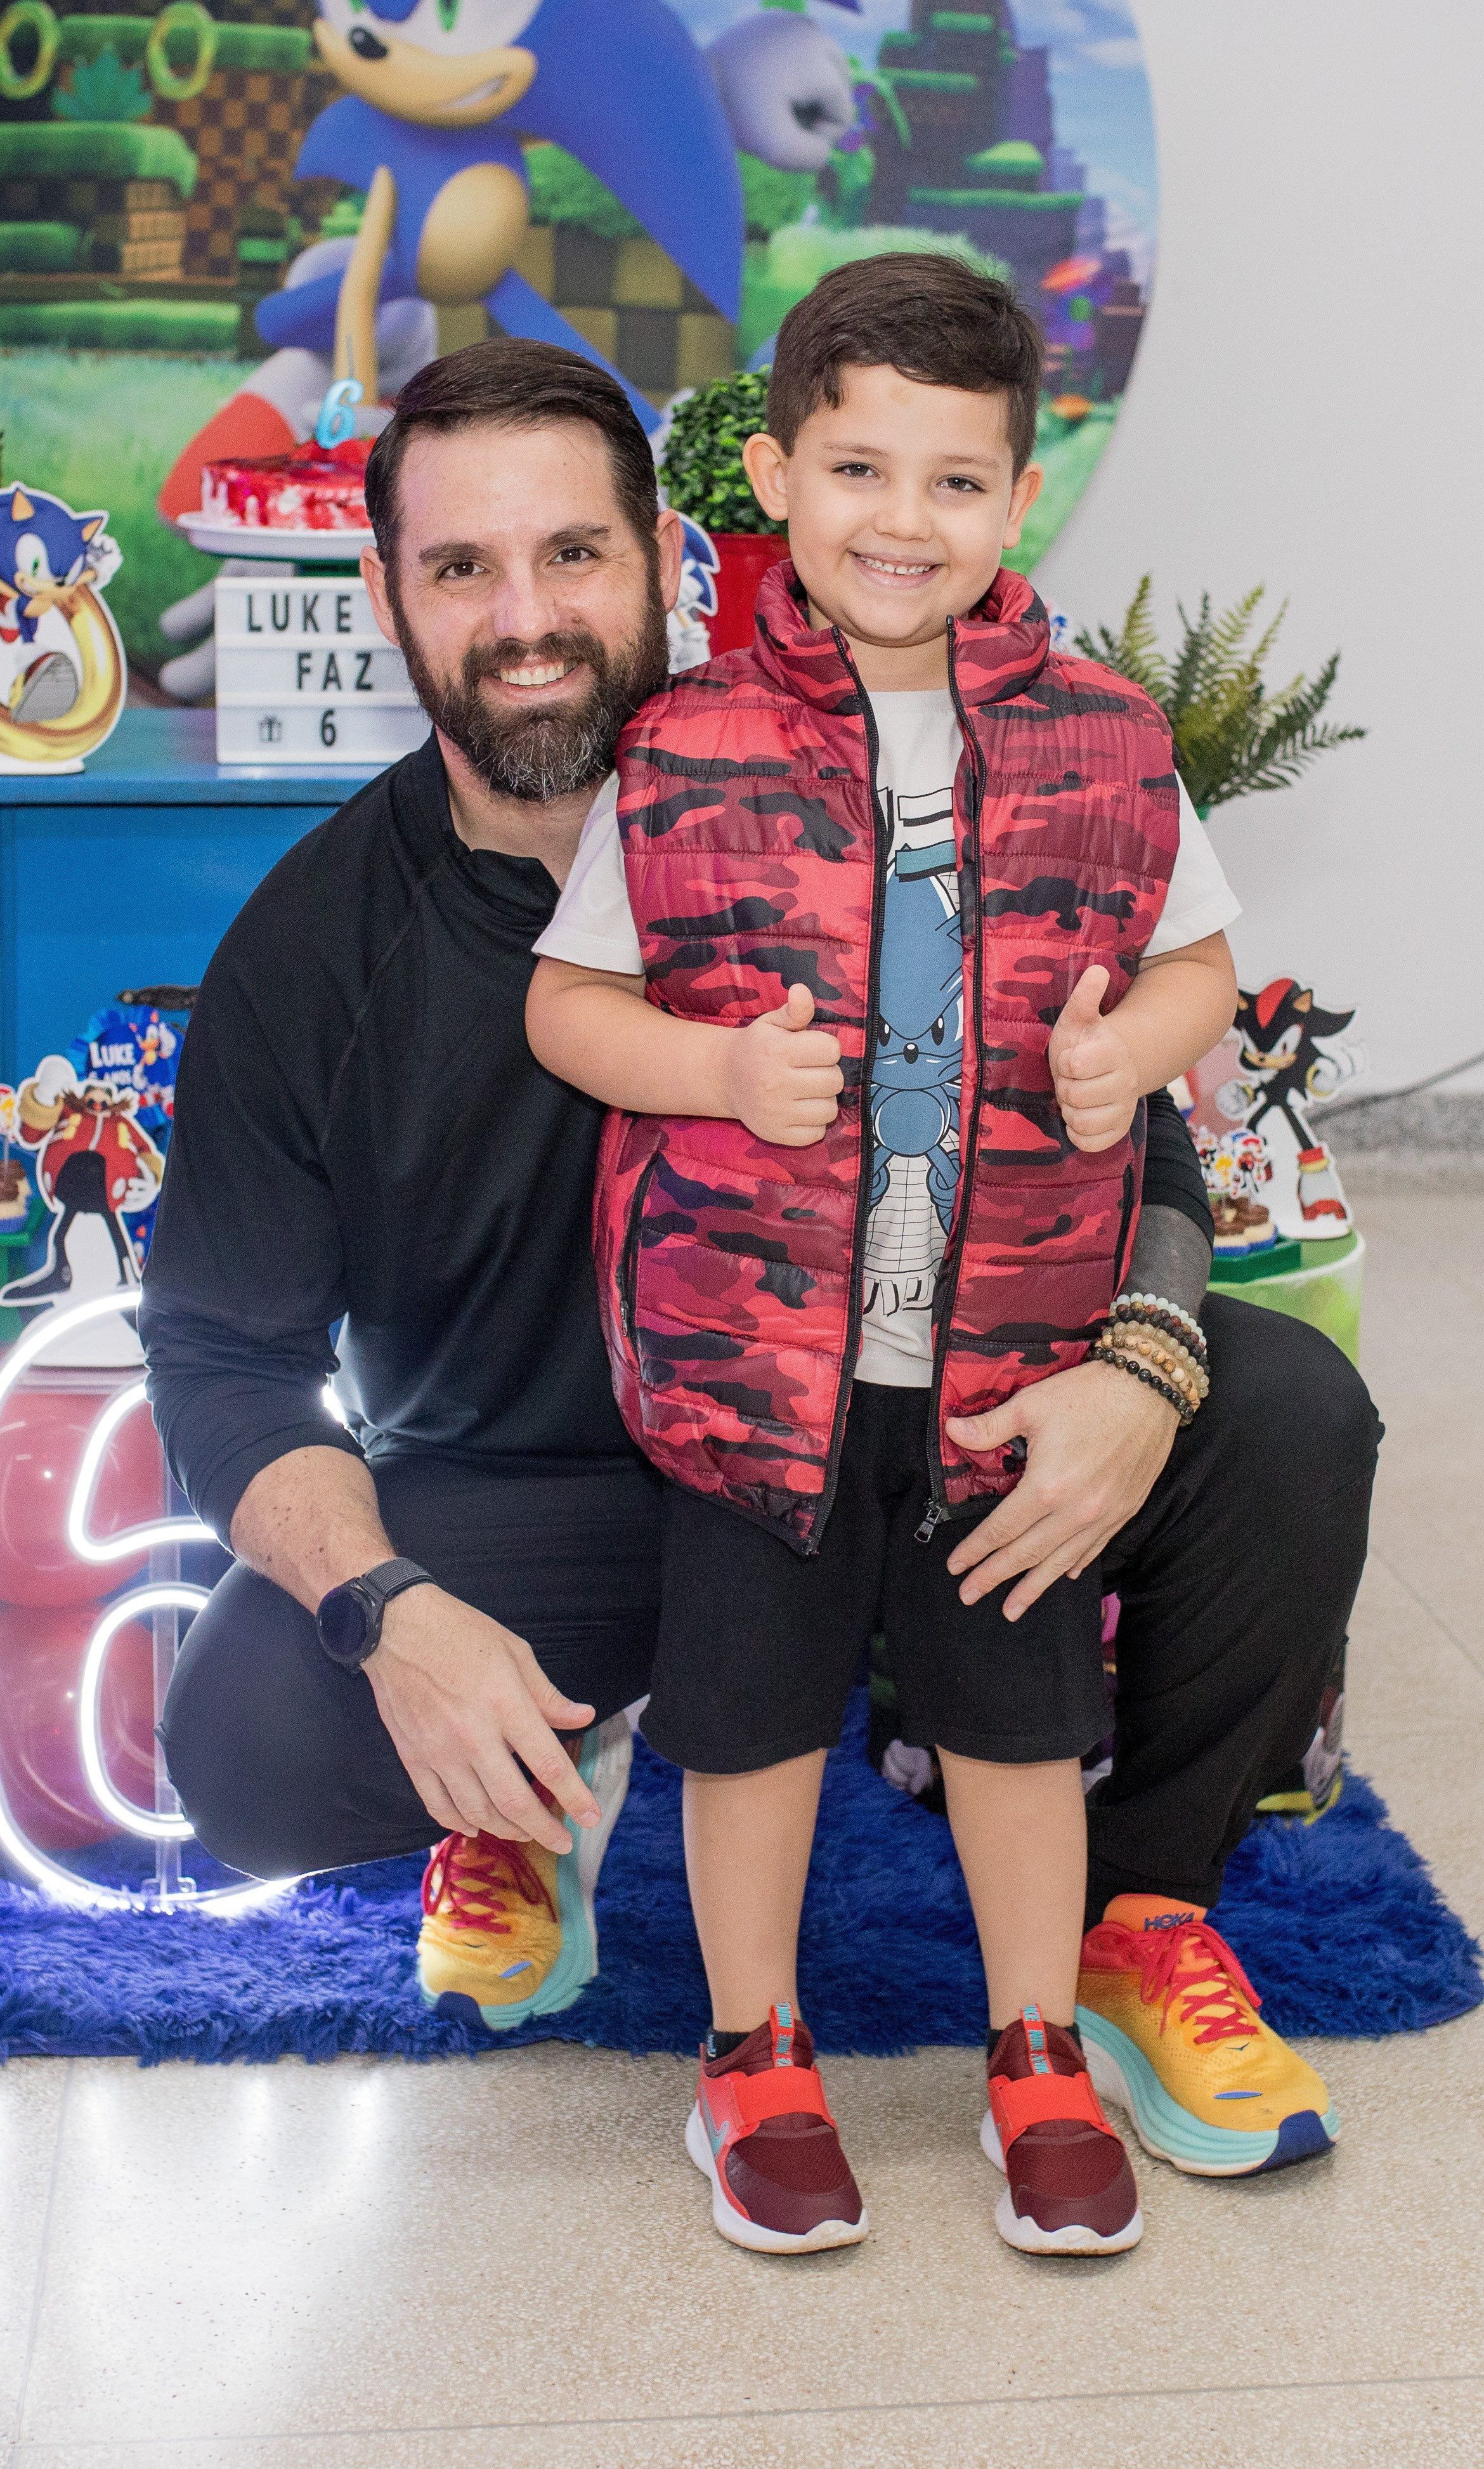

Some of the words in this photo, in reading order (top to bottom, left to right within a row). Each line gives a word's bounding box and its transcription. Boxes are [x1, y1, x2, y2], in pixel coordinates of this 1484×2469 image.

[316, 378, 363, 450] 6
[246, 593, 351, 633] LUKE
[296, 651, 373, 691] FAZ
[320, 708, 337, 748] 6
[89, 1041, 135, 1069] LUKE
